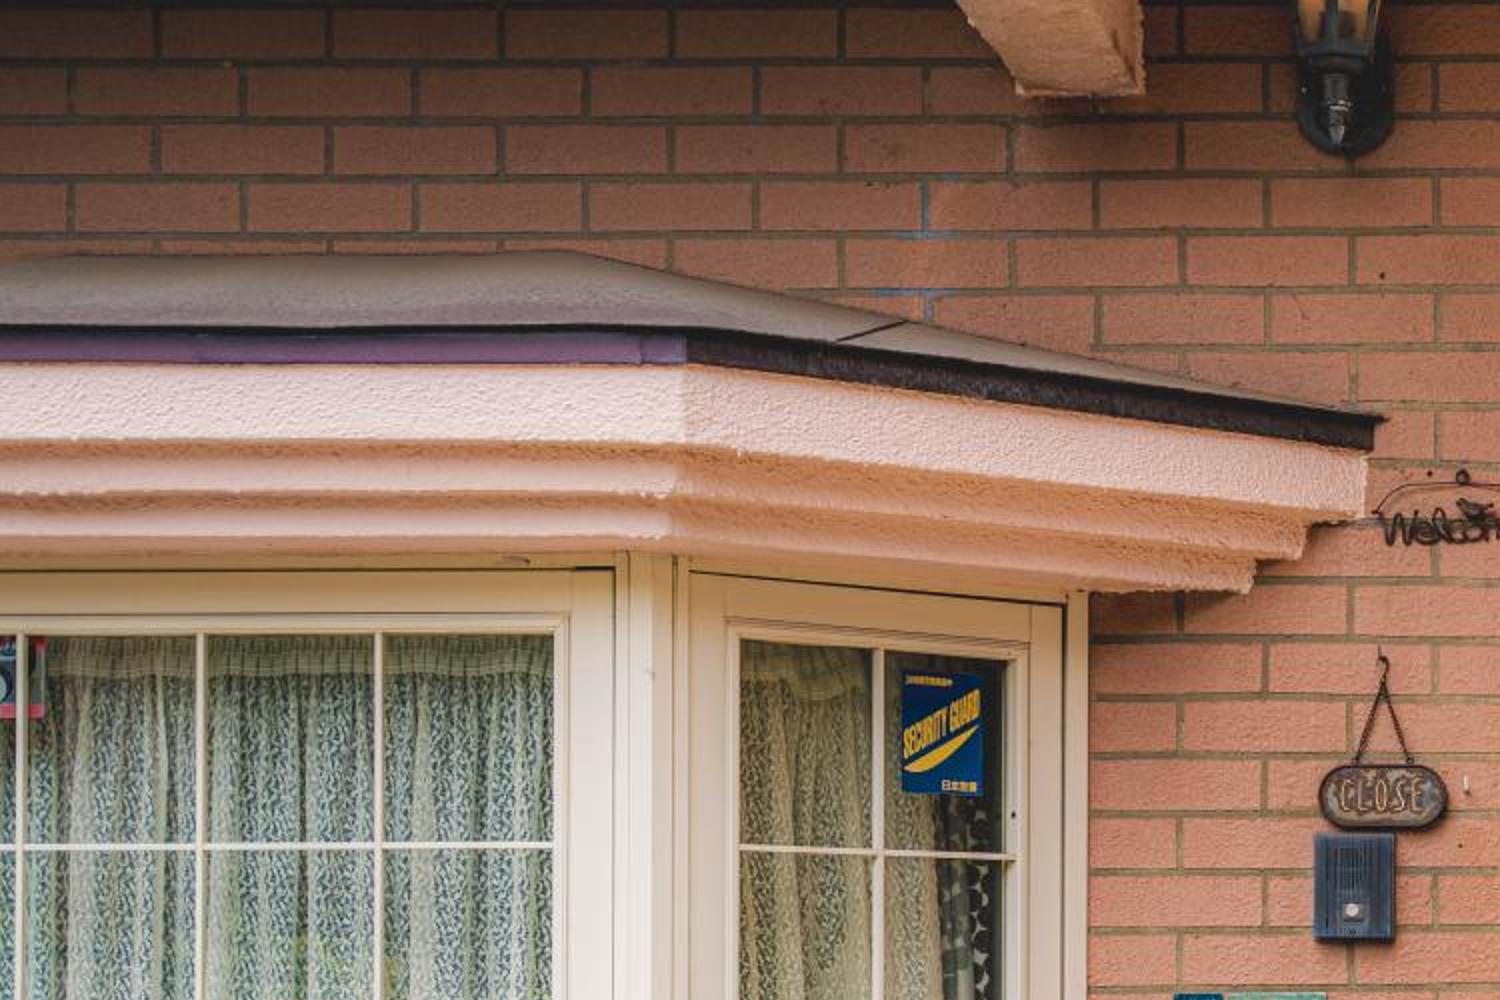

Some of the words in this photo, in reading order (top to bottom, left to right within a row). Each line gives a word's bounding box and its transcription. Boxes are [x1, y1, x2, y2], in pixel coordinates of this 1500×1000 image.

[903, 704, 949, 759] SECURITY
[949, 689, 980, 732] GUARD
[1340, 778, 1425, 812] CLOSE
